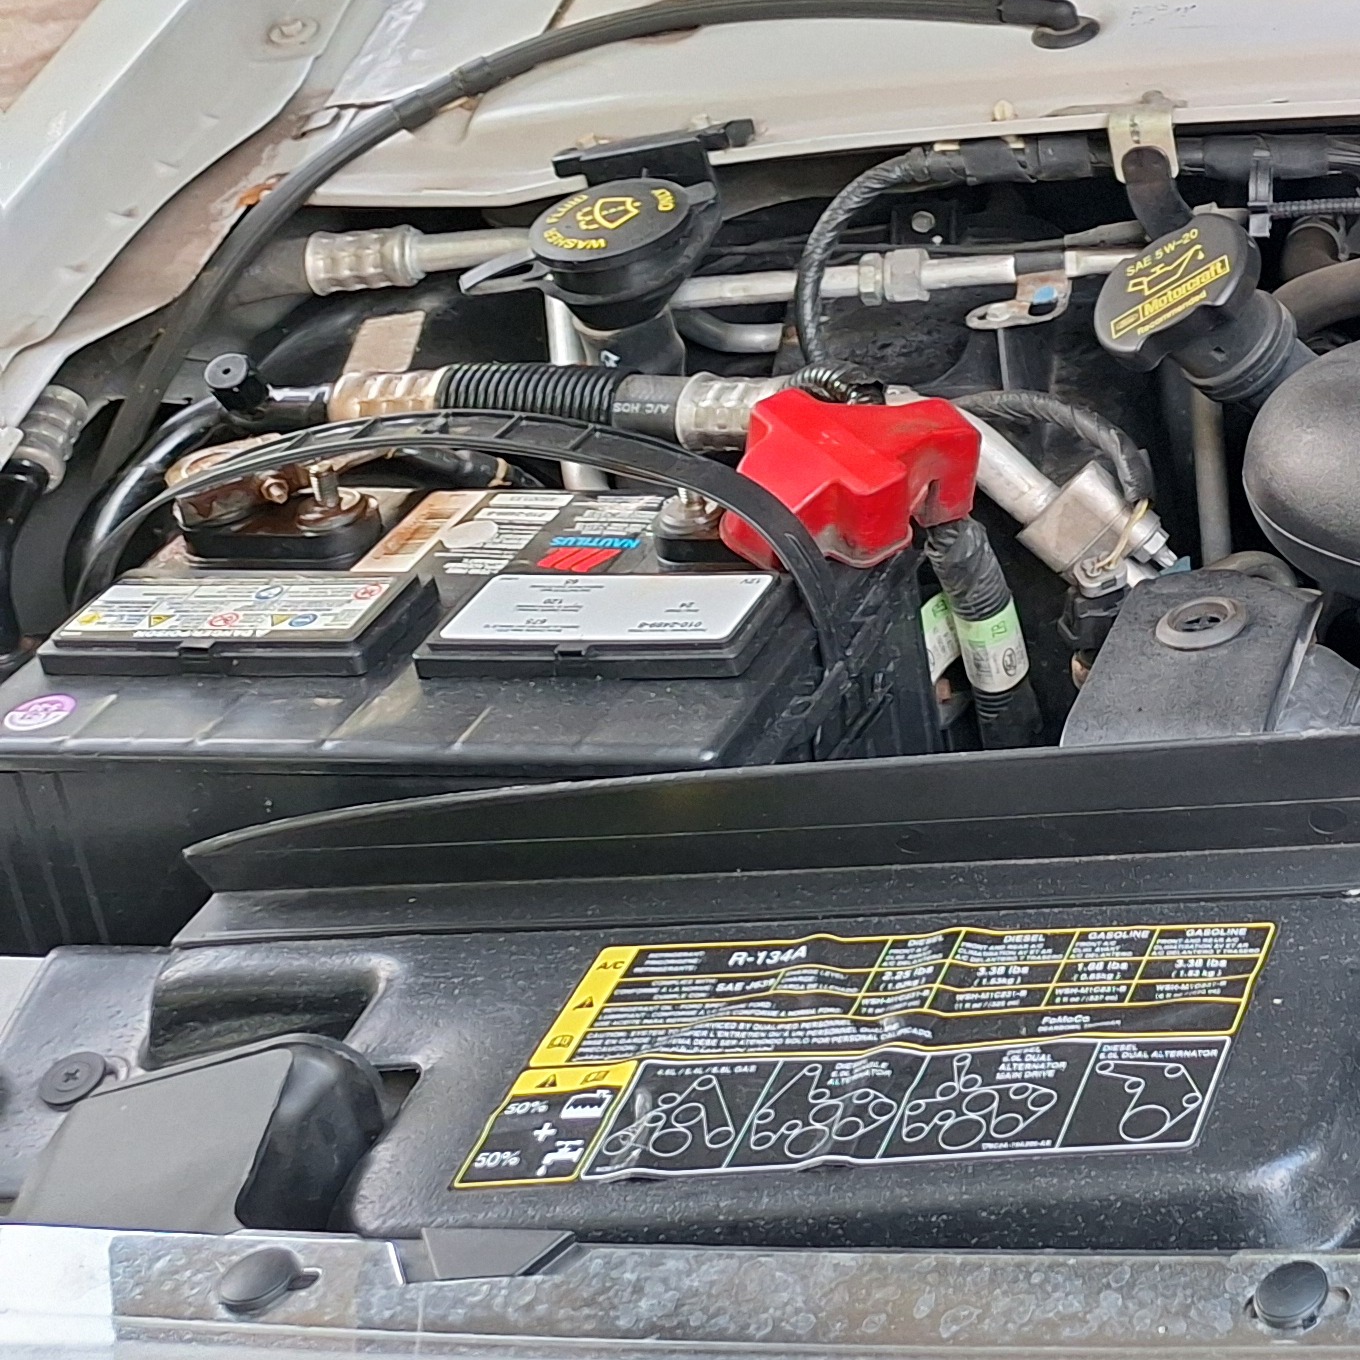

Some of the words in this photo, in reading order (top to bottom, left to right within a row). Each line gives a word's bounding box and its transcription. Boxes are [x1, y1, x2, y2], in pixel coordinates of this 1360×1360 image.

[546, 194, 589, 224] FLUID
[543, 227, 607, 250] WASHER
[1126, 254, 1152, 277] SAE
[1137, 290, 1207, 336] Recommended
[644, 403, 670, 414] A/C
[548, 536, 641, 550] NAUTILUS
[1088, 929, 1150, 940] GASOLINE
[1185, 928, 1248, 937] GASOLINE
[1002, 934, 1045, 943] DIESEL
[728, 946, 808, 967] R-134A
[596, 961, 625, 970] A/C
[715, 982, 744, 993] SAE
[1041, 1015, 1091, 1024] FoMoCo
[1102, 1043, 1138, 1052] DIESEL
[1024, 1053, 1053, 1062] DUAL
[1122, 1050, 1149, 1059] DUAL
[1151, 1049, 1218, 1058] ALTERNATOR
[999, 1061, 1068, 1071] ALTERNATOR
[996, 1070, 1023, 1080] MAIN
[1024, 1069, 1056, 1079] DRIVE
[503, 1100, 549, 1115] 50%
[474, 1150, 521, 1169] 50%
